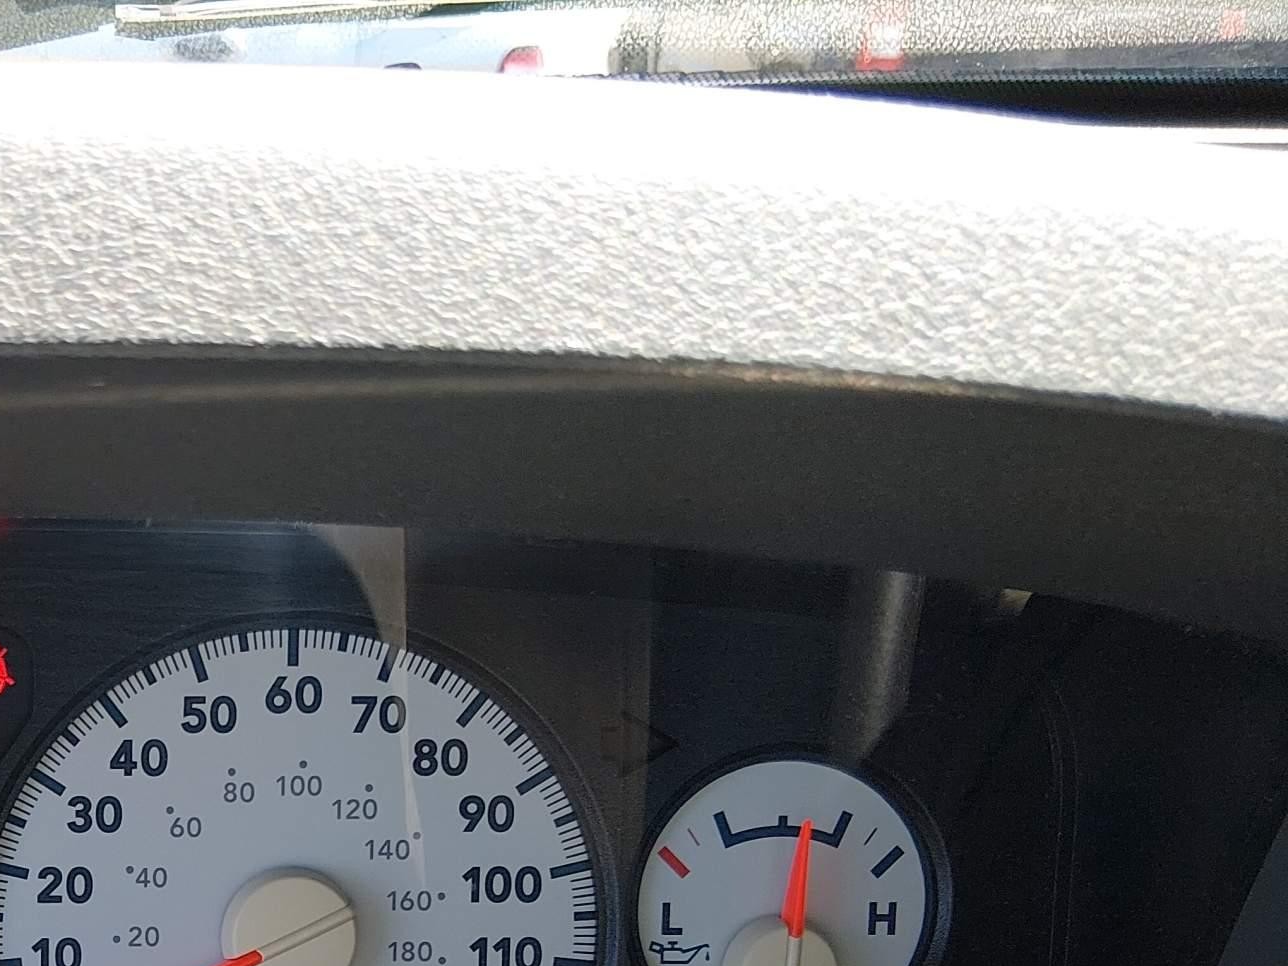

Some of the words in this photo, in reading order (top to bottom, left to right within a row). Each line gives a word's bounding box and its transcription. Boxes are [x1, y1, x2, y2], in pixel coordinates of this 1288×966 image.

[266, 676, 322, 714] 60
[181, 696, 236, 733] 50
[352, 696, 406, 733] 70
[110, 739, 168, 776] 40
[413, 739, 468, 776] 80
[224, 783, 254, 802] 80
[277, 776, 322, 796] 100
[67, 796, 122, 833] 30
[333, 799, 377, 819] 120
[459, 795, 514, 832] 90
[170, 817, 201, 837] 60
[366, 840, 409, 860] 140
[37, 867, 93, 903] 20
[136, 868, 167, 888] 40
[462, 866, 541, 903] 100
[387, 891, 431, 911] 160
[662, 903, 682, 935] L
[868, 902, 897, 935] H
[129, 927, 159, 946] 20
[389, 942, 432, 961] 180
